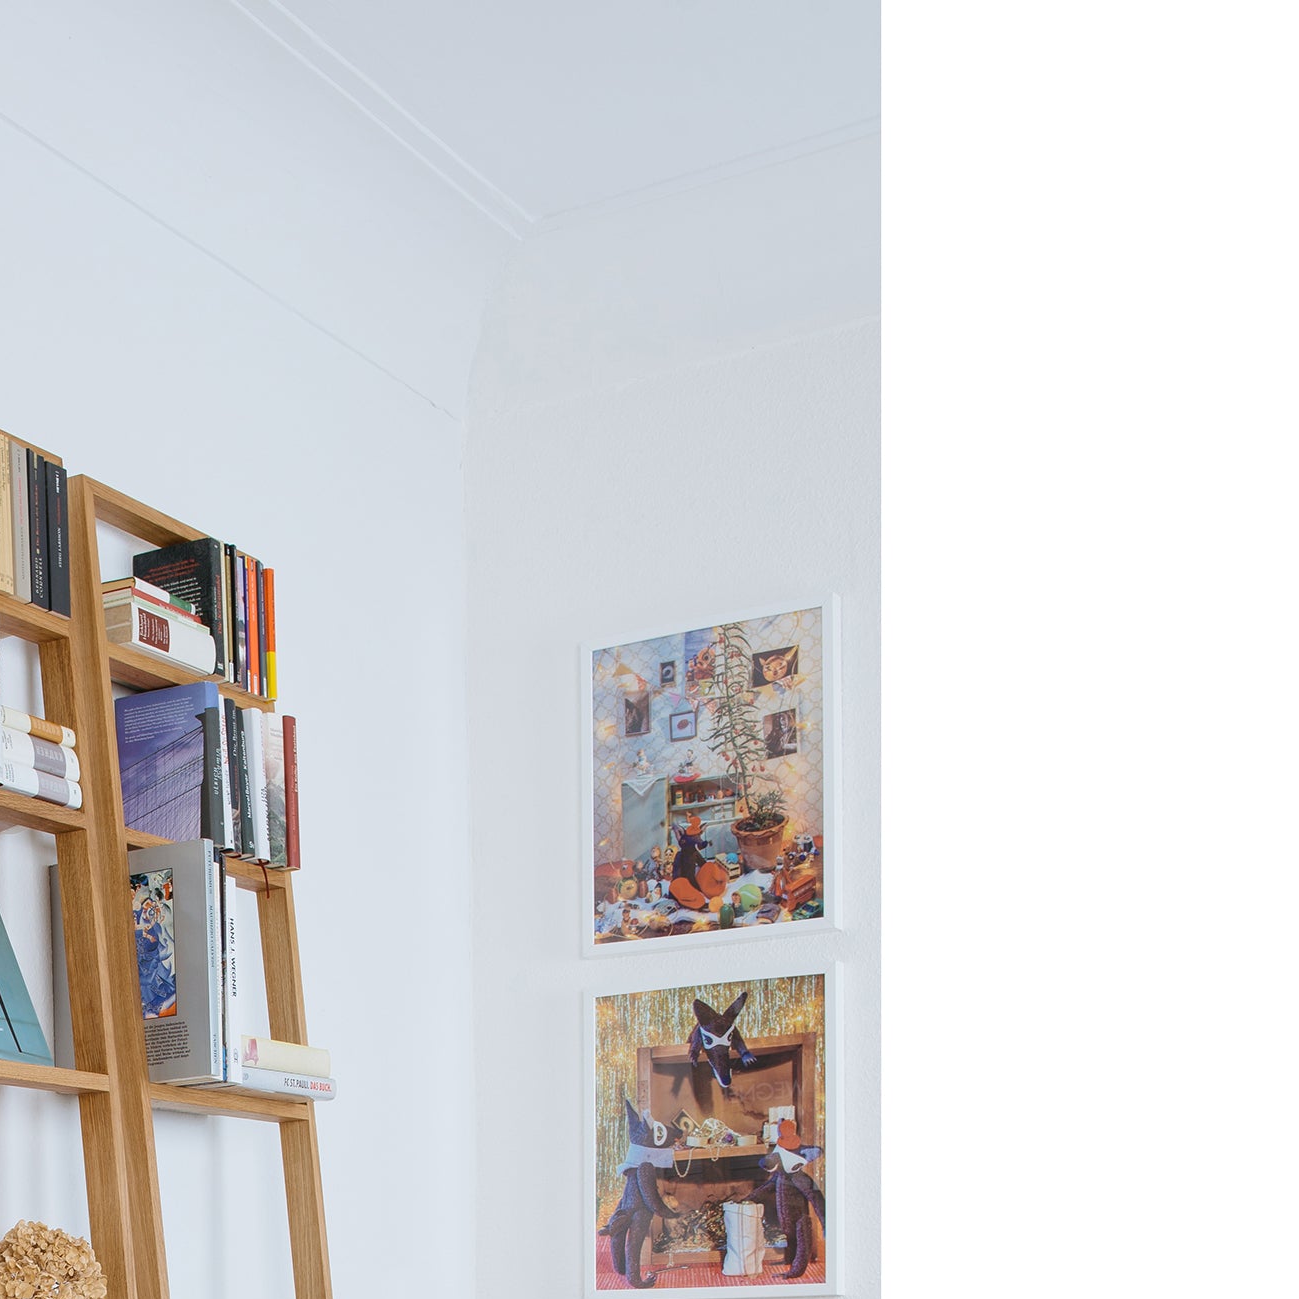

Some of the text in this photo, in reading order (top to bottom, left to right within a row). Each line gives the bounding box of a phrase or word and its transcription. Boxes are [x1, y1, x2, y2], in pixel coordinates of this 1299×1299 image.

[230, 957, 238, 997] WEGNER
[284, 1077, 290, 1087] FC
[310, 1081, 319, 1091] DAS
